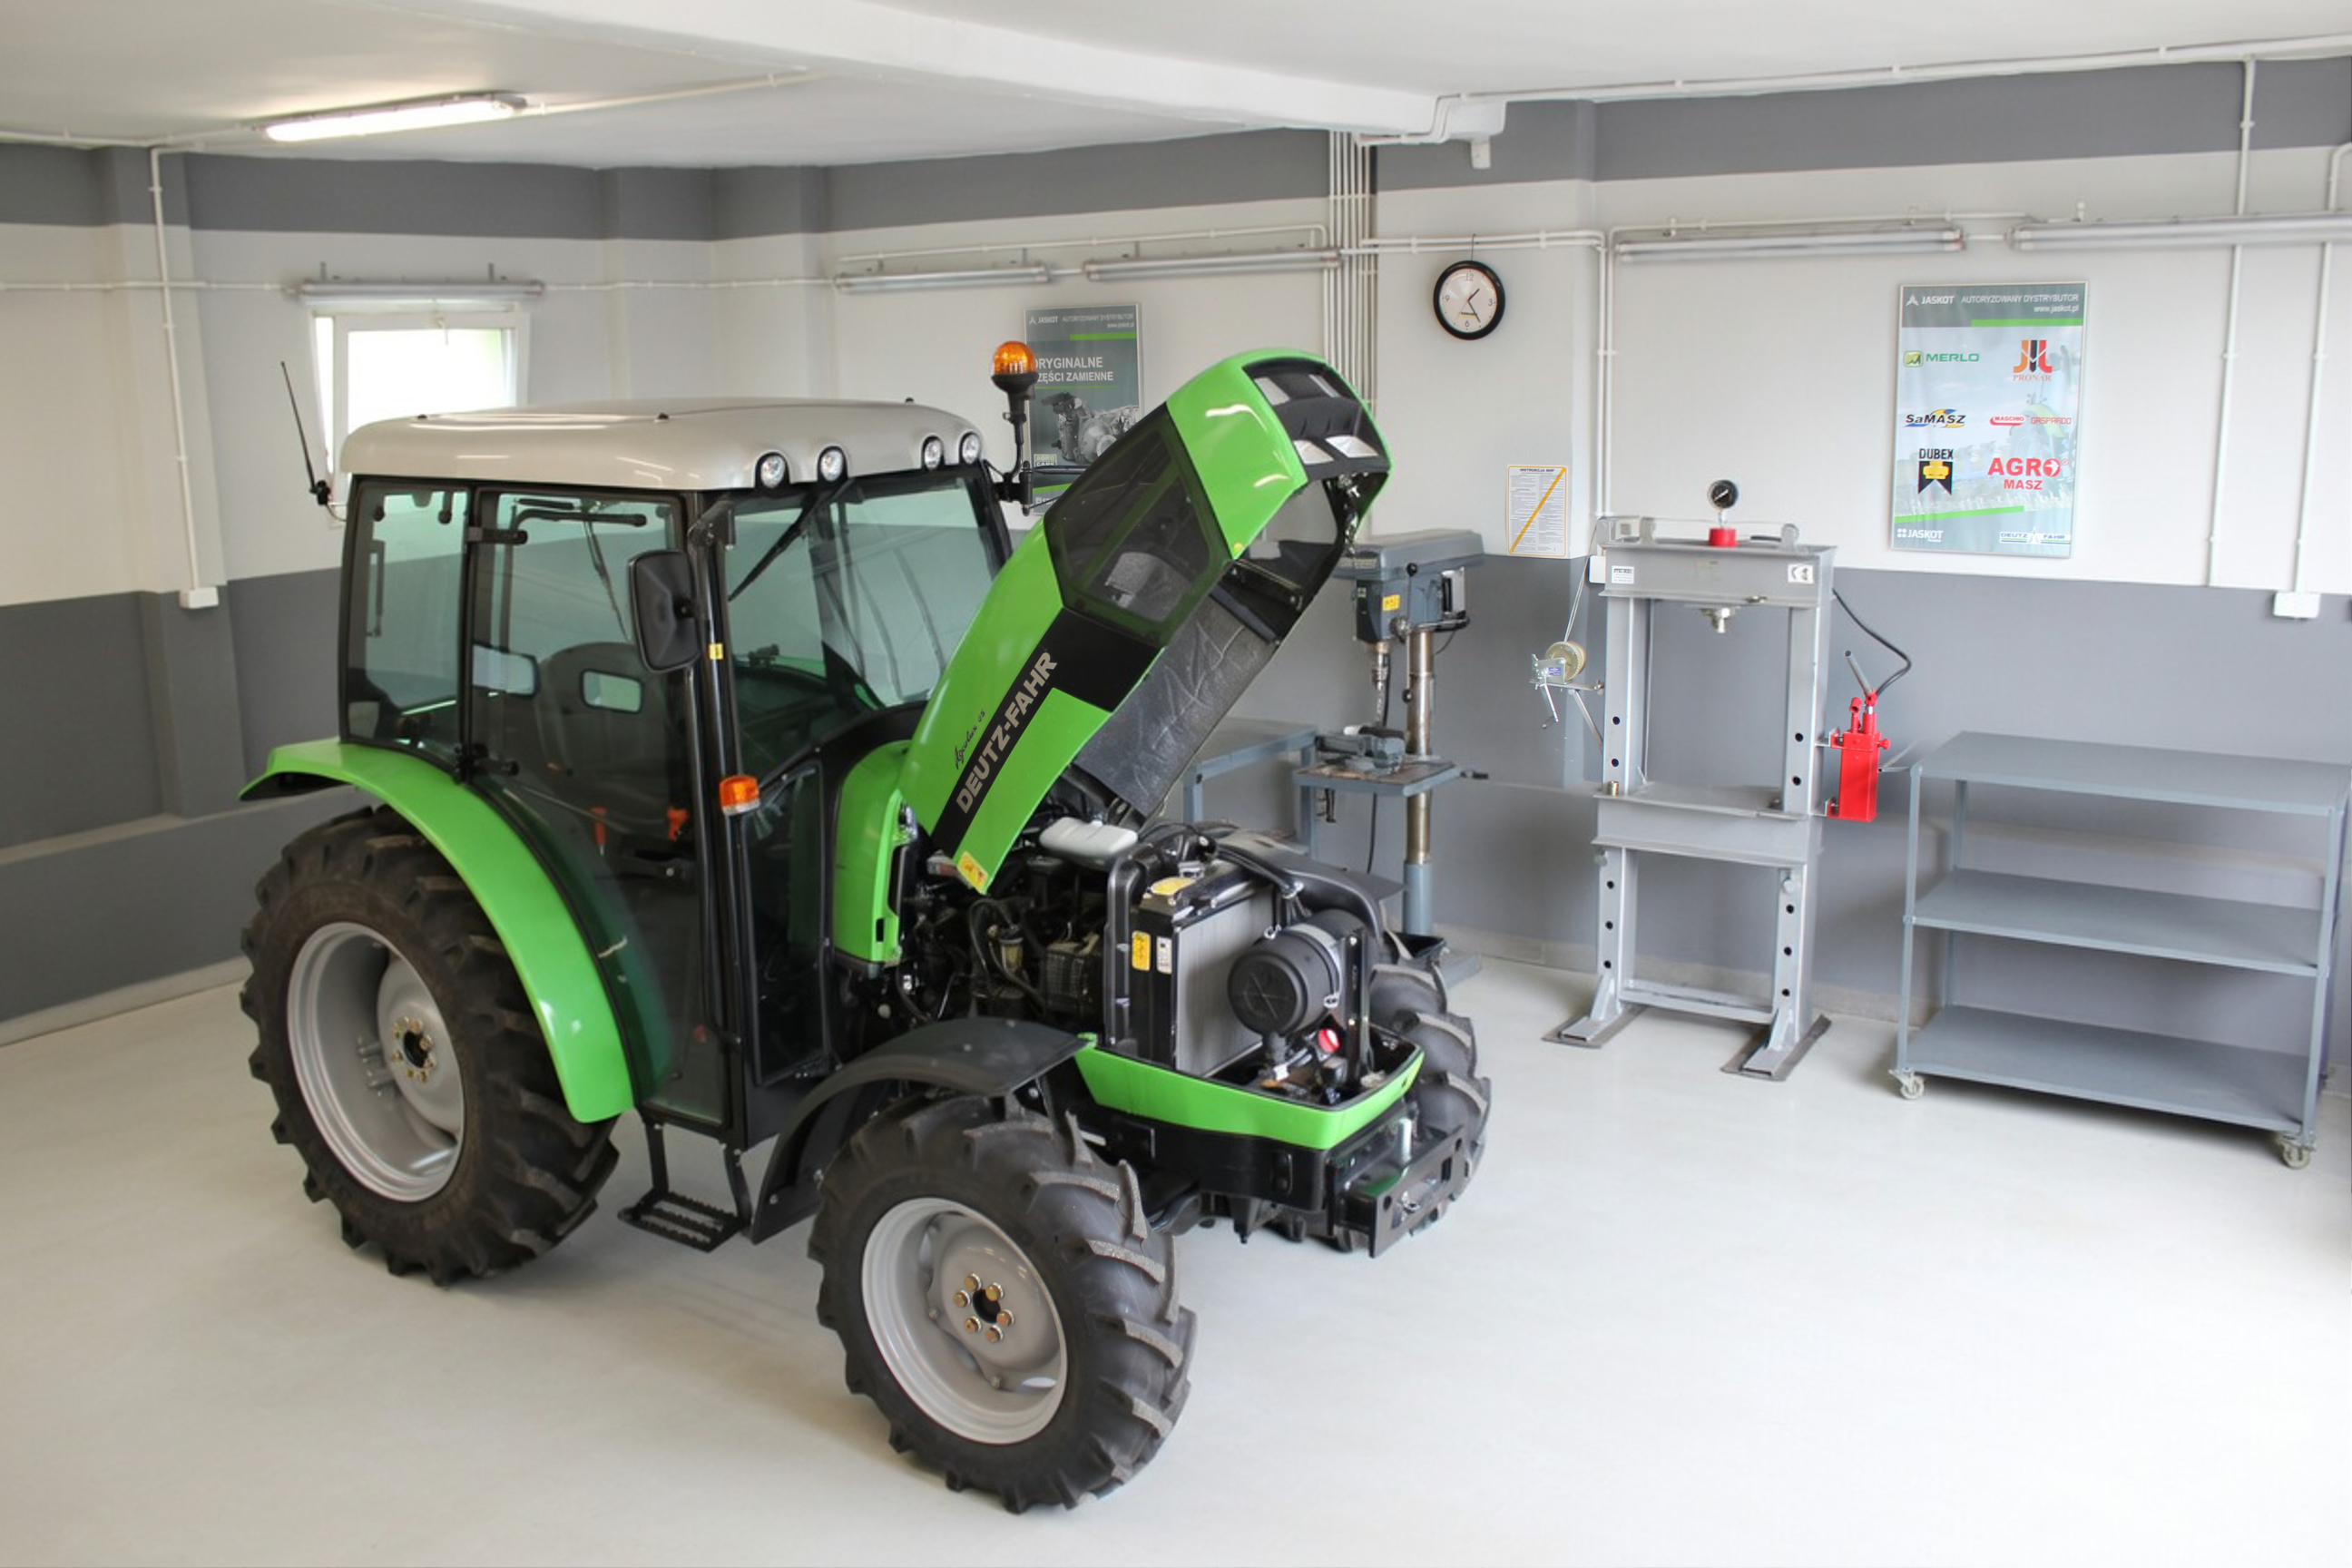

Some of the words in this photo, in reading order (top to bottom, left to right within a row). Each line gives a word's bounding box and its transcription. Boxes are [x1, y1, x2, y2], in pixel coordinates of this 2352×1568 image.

[1465, 273, 1474, 281] 12
[1921, 295, 1955, 305] JASKOT
[1961, 295, 2023, 304] AUTORYZOWANY
[2023, 294, 2079, 303] DYSTRYBUTOR
[2034, 305, 2079, 313] www.jaskot.pl
[1926, 353, 1980, 362] MERLO
[1038, 370, 1063, 384] ZĘŚCI
[1066, 371, 1113, 381] ZAMIENNE
[1905, 413, 1966, 424] SaMASZ
[2030, 416, 2072, 425] GASPARDO
[1918, 448, 1954, 460] DUBEX
[1987, 457, 2062, 477] AGRO
[2004, 479, 2043, 490] MASZ
[1907, 529, 1944, 539] JASKOT
[956, 652, 1058, 814] DEUTZ-FAHR
